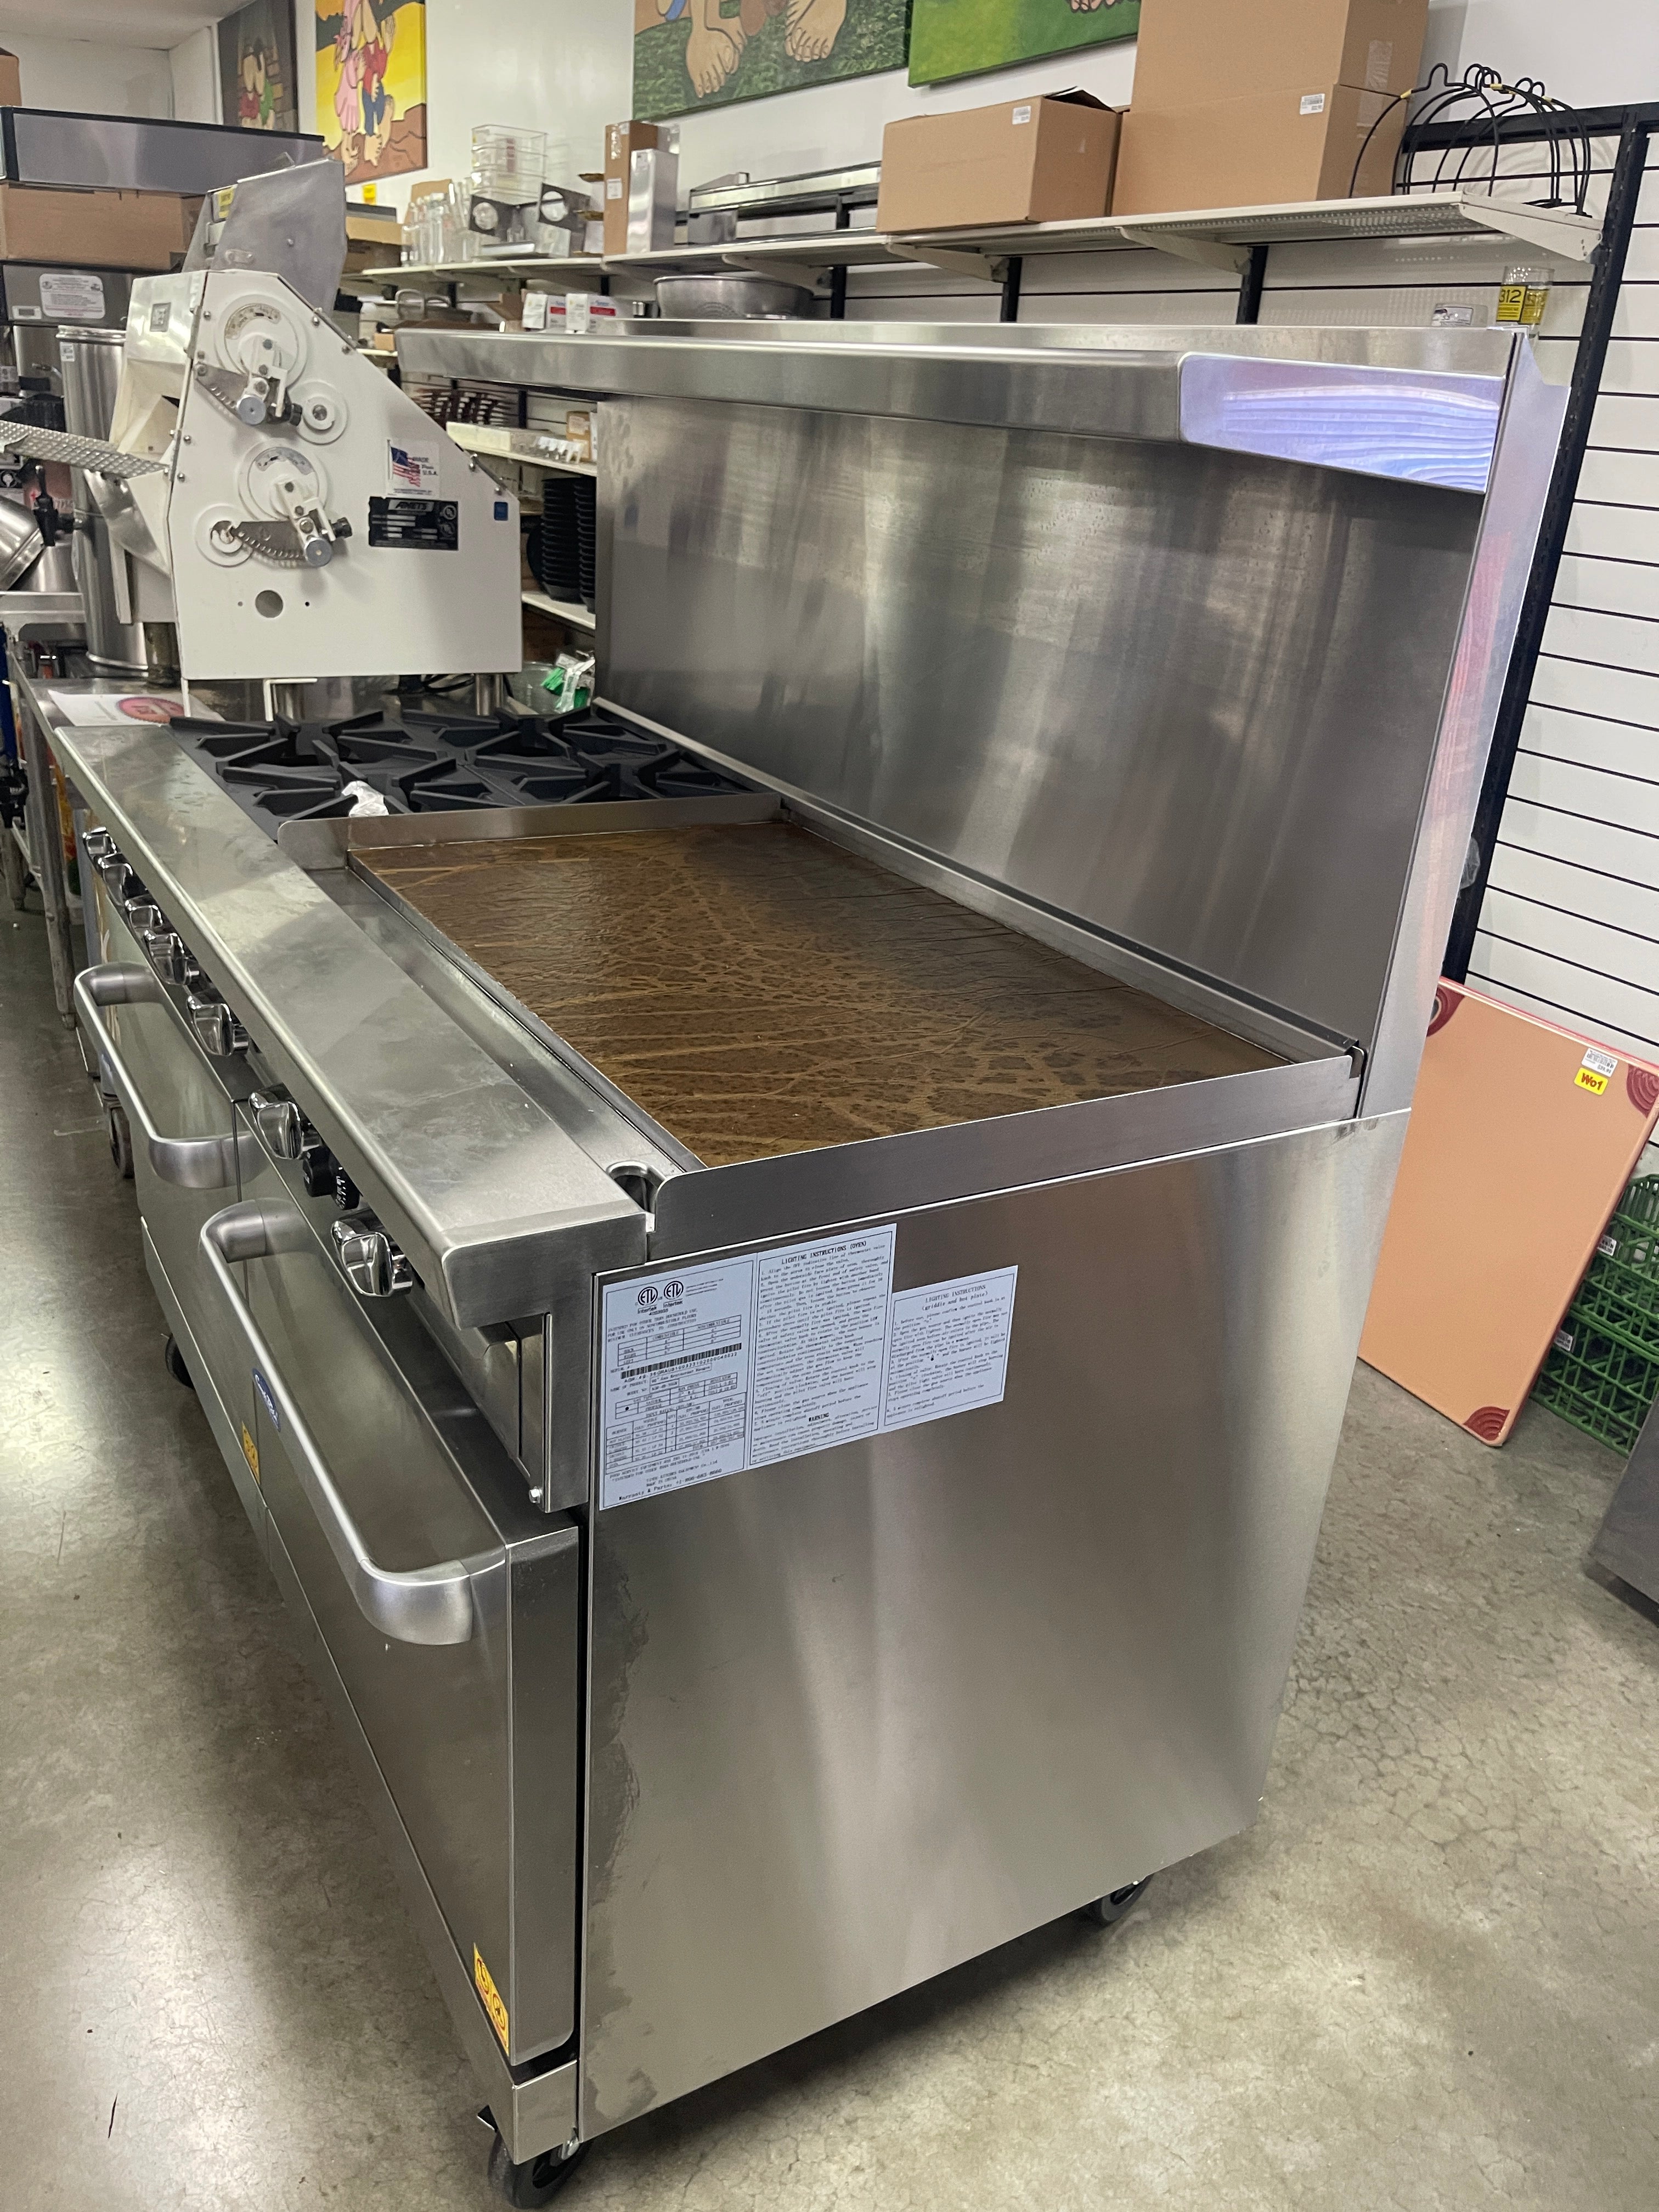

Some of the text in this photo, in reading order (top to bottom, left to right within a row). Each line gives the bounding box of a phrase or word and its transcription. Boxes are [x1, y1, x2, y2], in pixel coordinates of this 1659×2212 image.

[1581, 1073, 1603, 1091] Wo1
[639, 1286, 656, 1306] ETL
[665, 1280, 682, 1300] ETL
[637, 1305, 657, 1314] Intertek
[663, 1299, 683, 1308] Intertek
